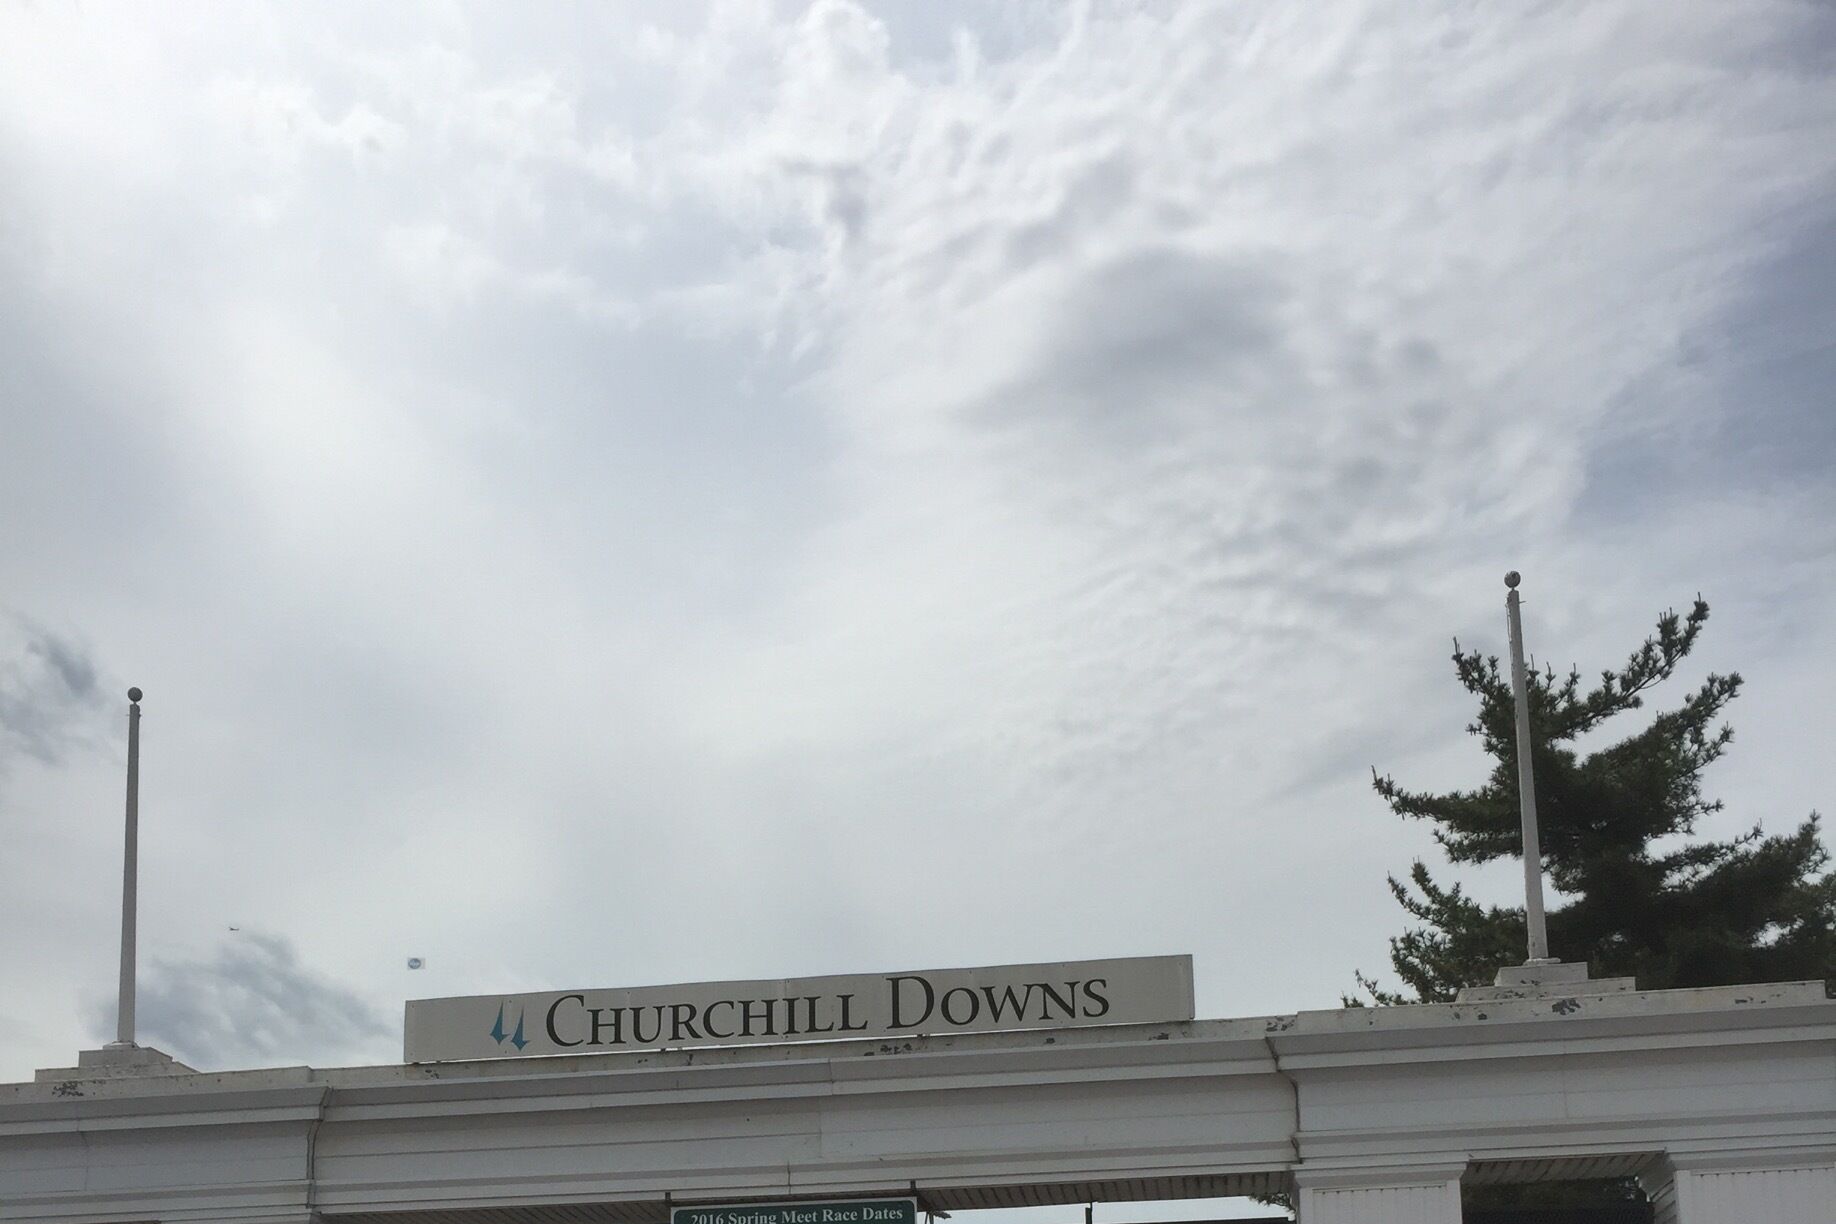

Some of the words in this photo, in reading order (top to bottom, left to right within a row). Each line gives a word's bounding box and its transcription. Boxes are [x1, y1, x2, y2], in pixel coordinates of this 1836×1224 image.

[545, 993, 868, 1046] CHURCHILL
[886, 975, 1110, 1029] DOWNS
[781, 1210, 818, 1224] Meet
[822, 1208, 858, 1222] Race
[862, 1207, 903, 1221] Dates
